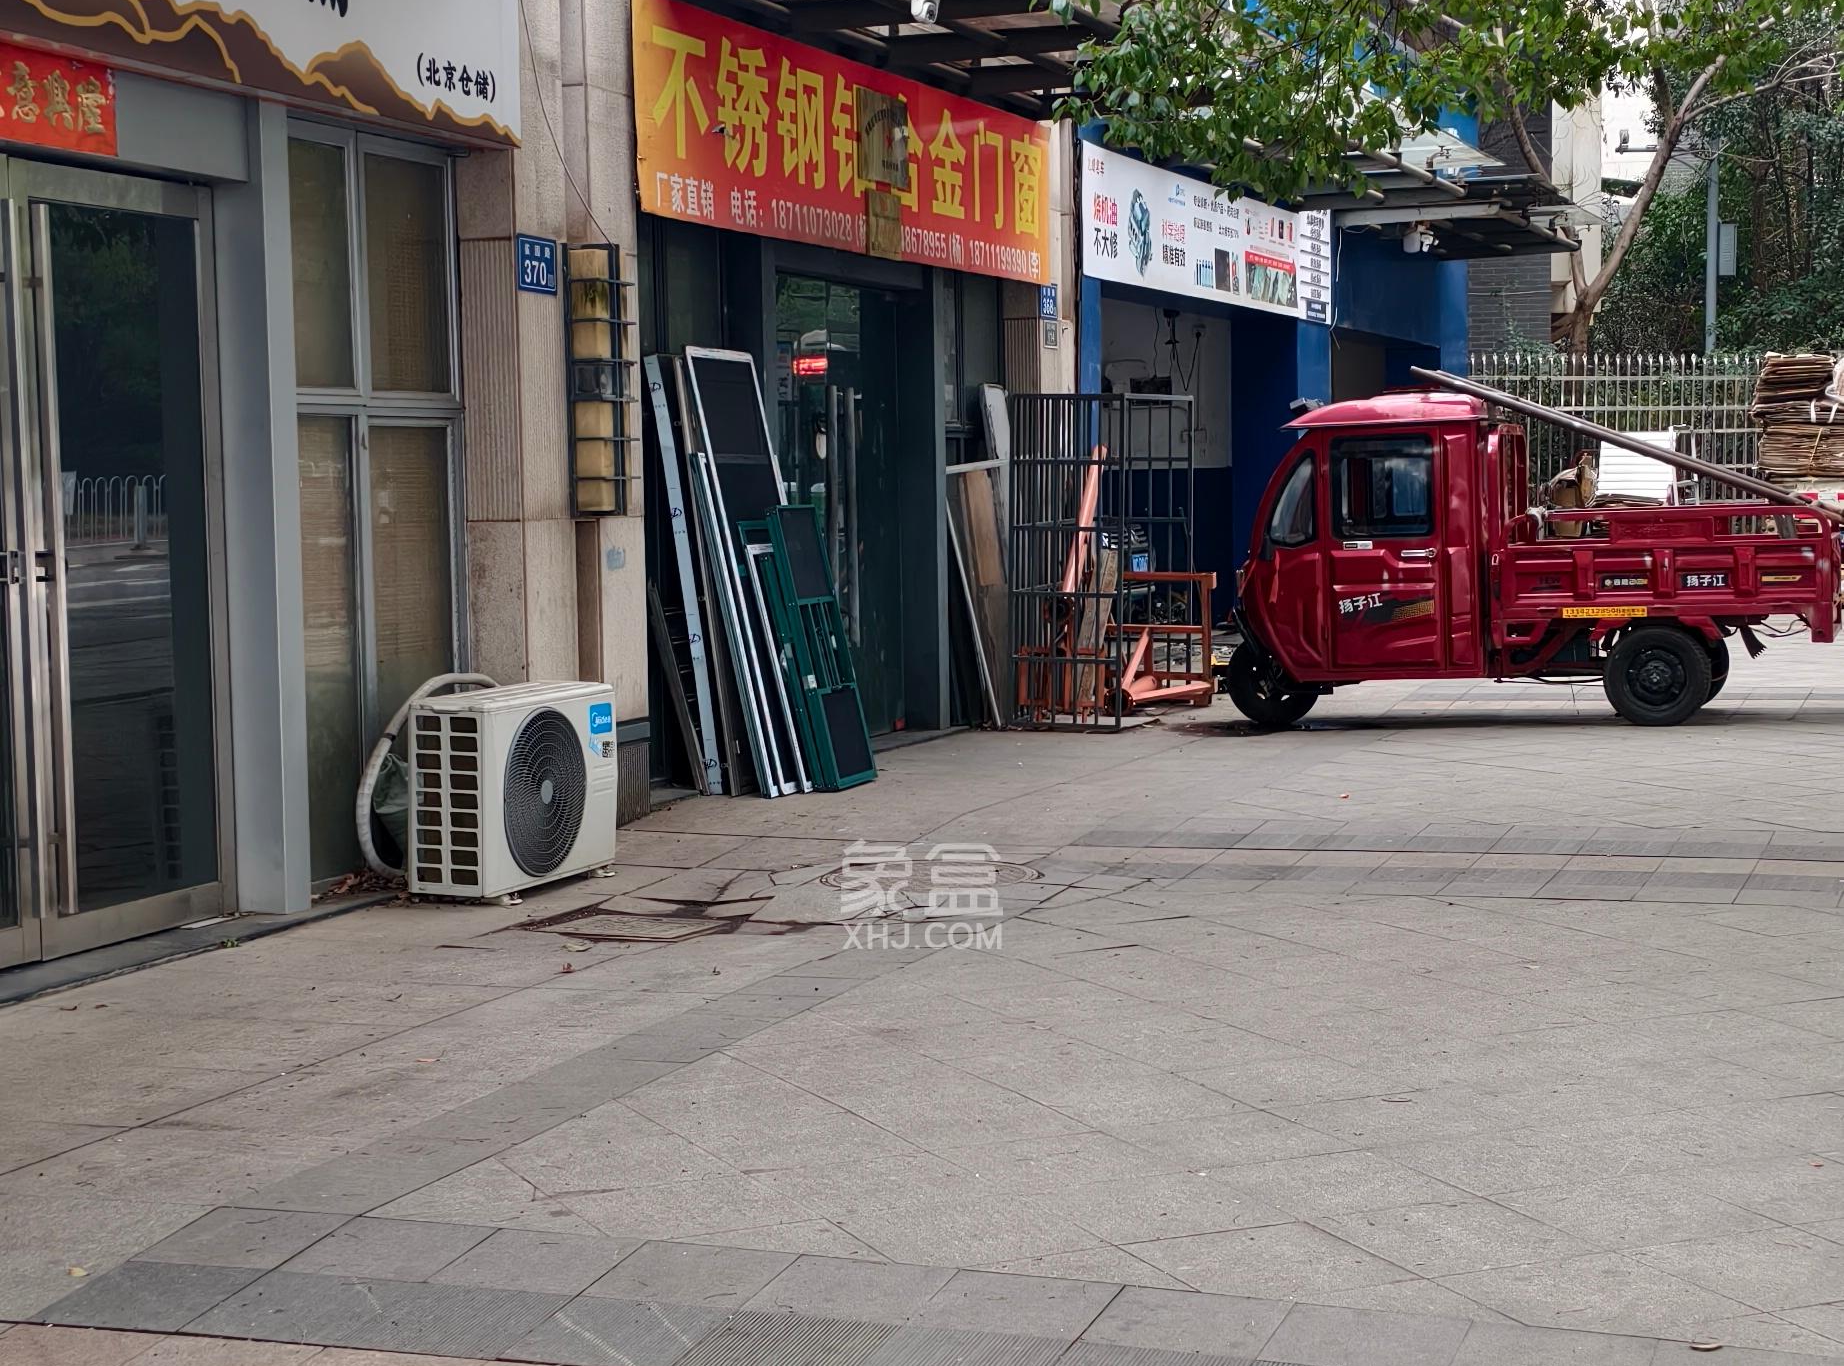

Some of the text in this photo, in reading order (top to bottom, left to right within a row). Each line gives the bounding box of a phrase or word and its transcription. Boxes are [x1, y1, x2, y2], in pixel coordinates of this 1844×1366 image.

[655, 171, 715, 220] 厂家直销
[1093, 227, 1119, 259] 不大修
[1686, 574, 1726, 587] 扬子江
[1338, 592, 1383, 614] 扬子江
